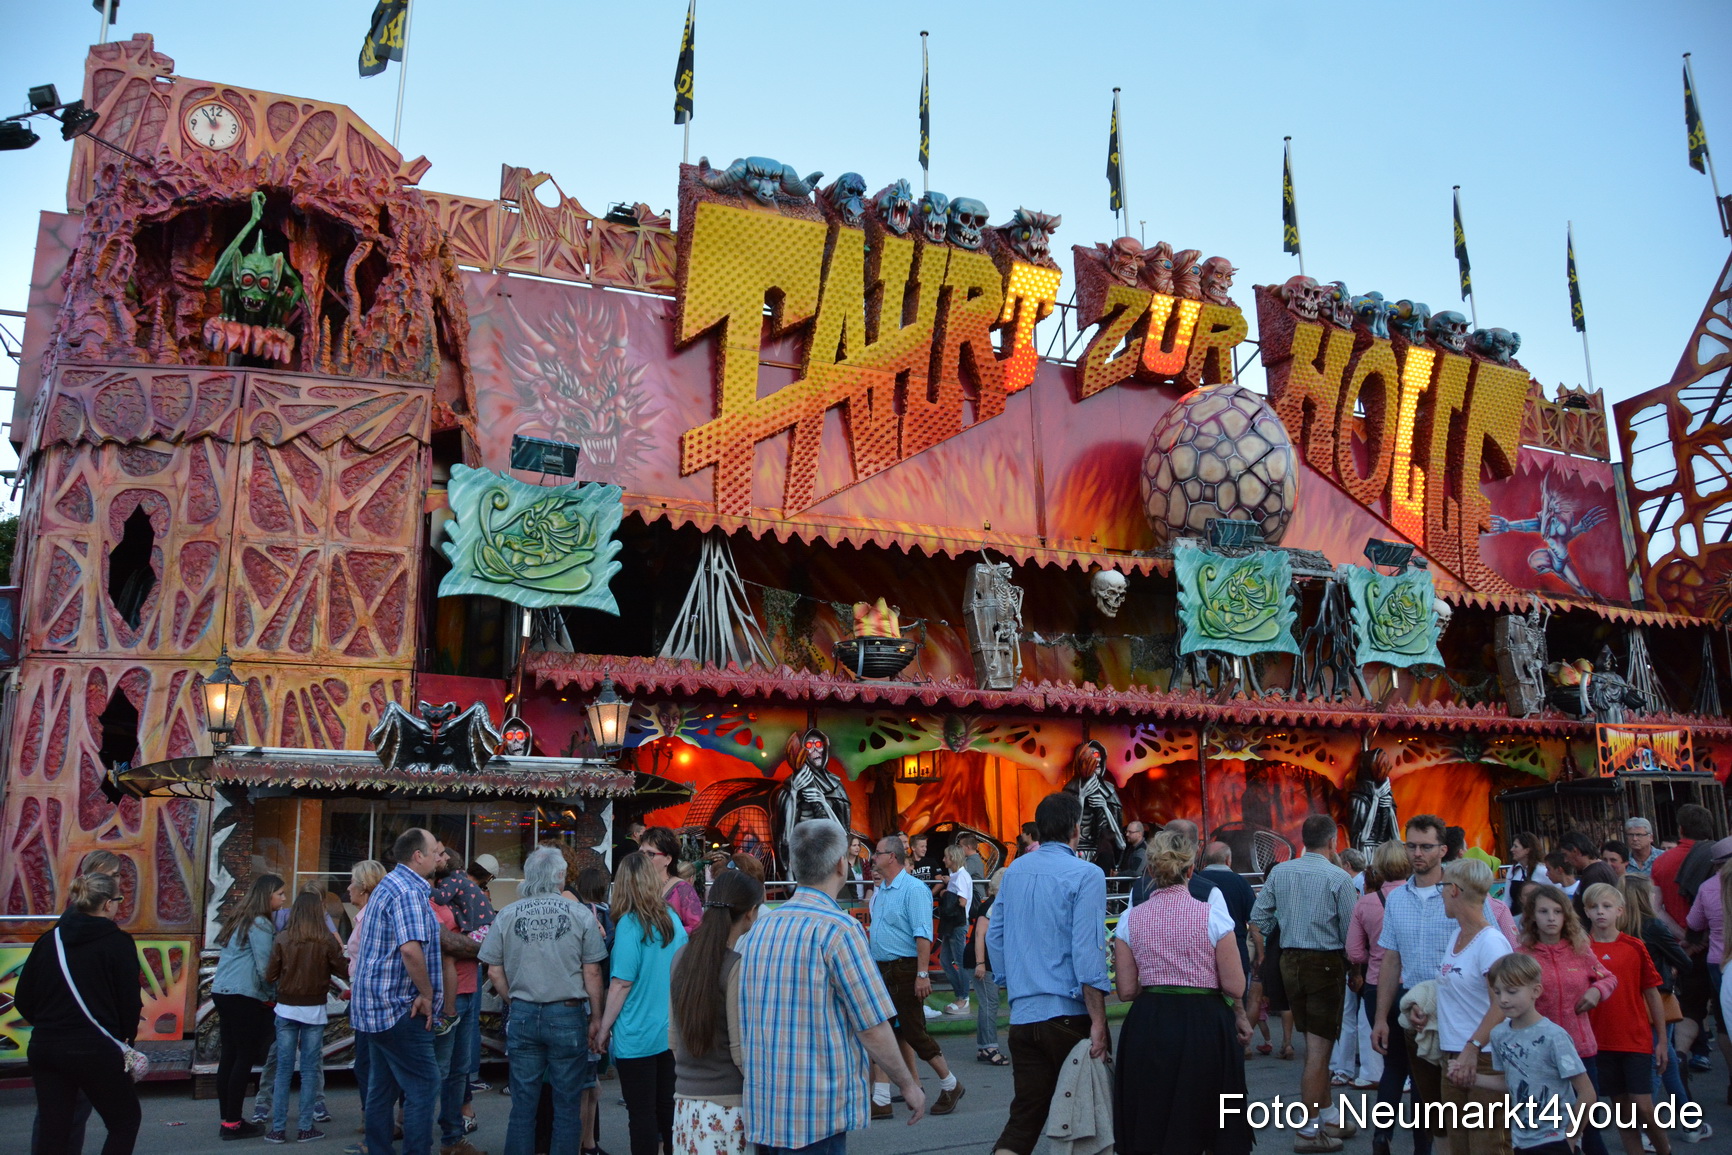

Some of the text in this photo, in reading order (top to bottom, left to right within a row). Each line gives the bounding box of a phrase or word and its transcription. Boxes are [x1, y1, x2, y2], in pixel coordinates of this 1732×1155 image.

[210, 105, 223, 117] 12
[191, 119, 197, 130] 9
[231, 124, 238, 134] 3
[209, 134, 215, 147] 6
[673, 202, 1061, 519] FAHRT
[1076, 284, 1248, 400] ZUR
[526, 906, 559, 916] NEW YORK
